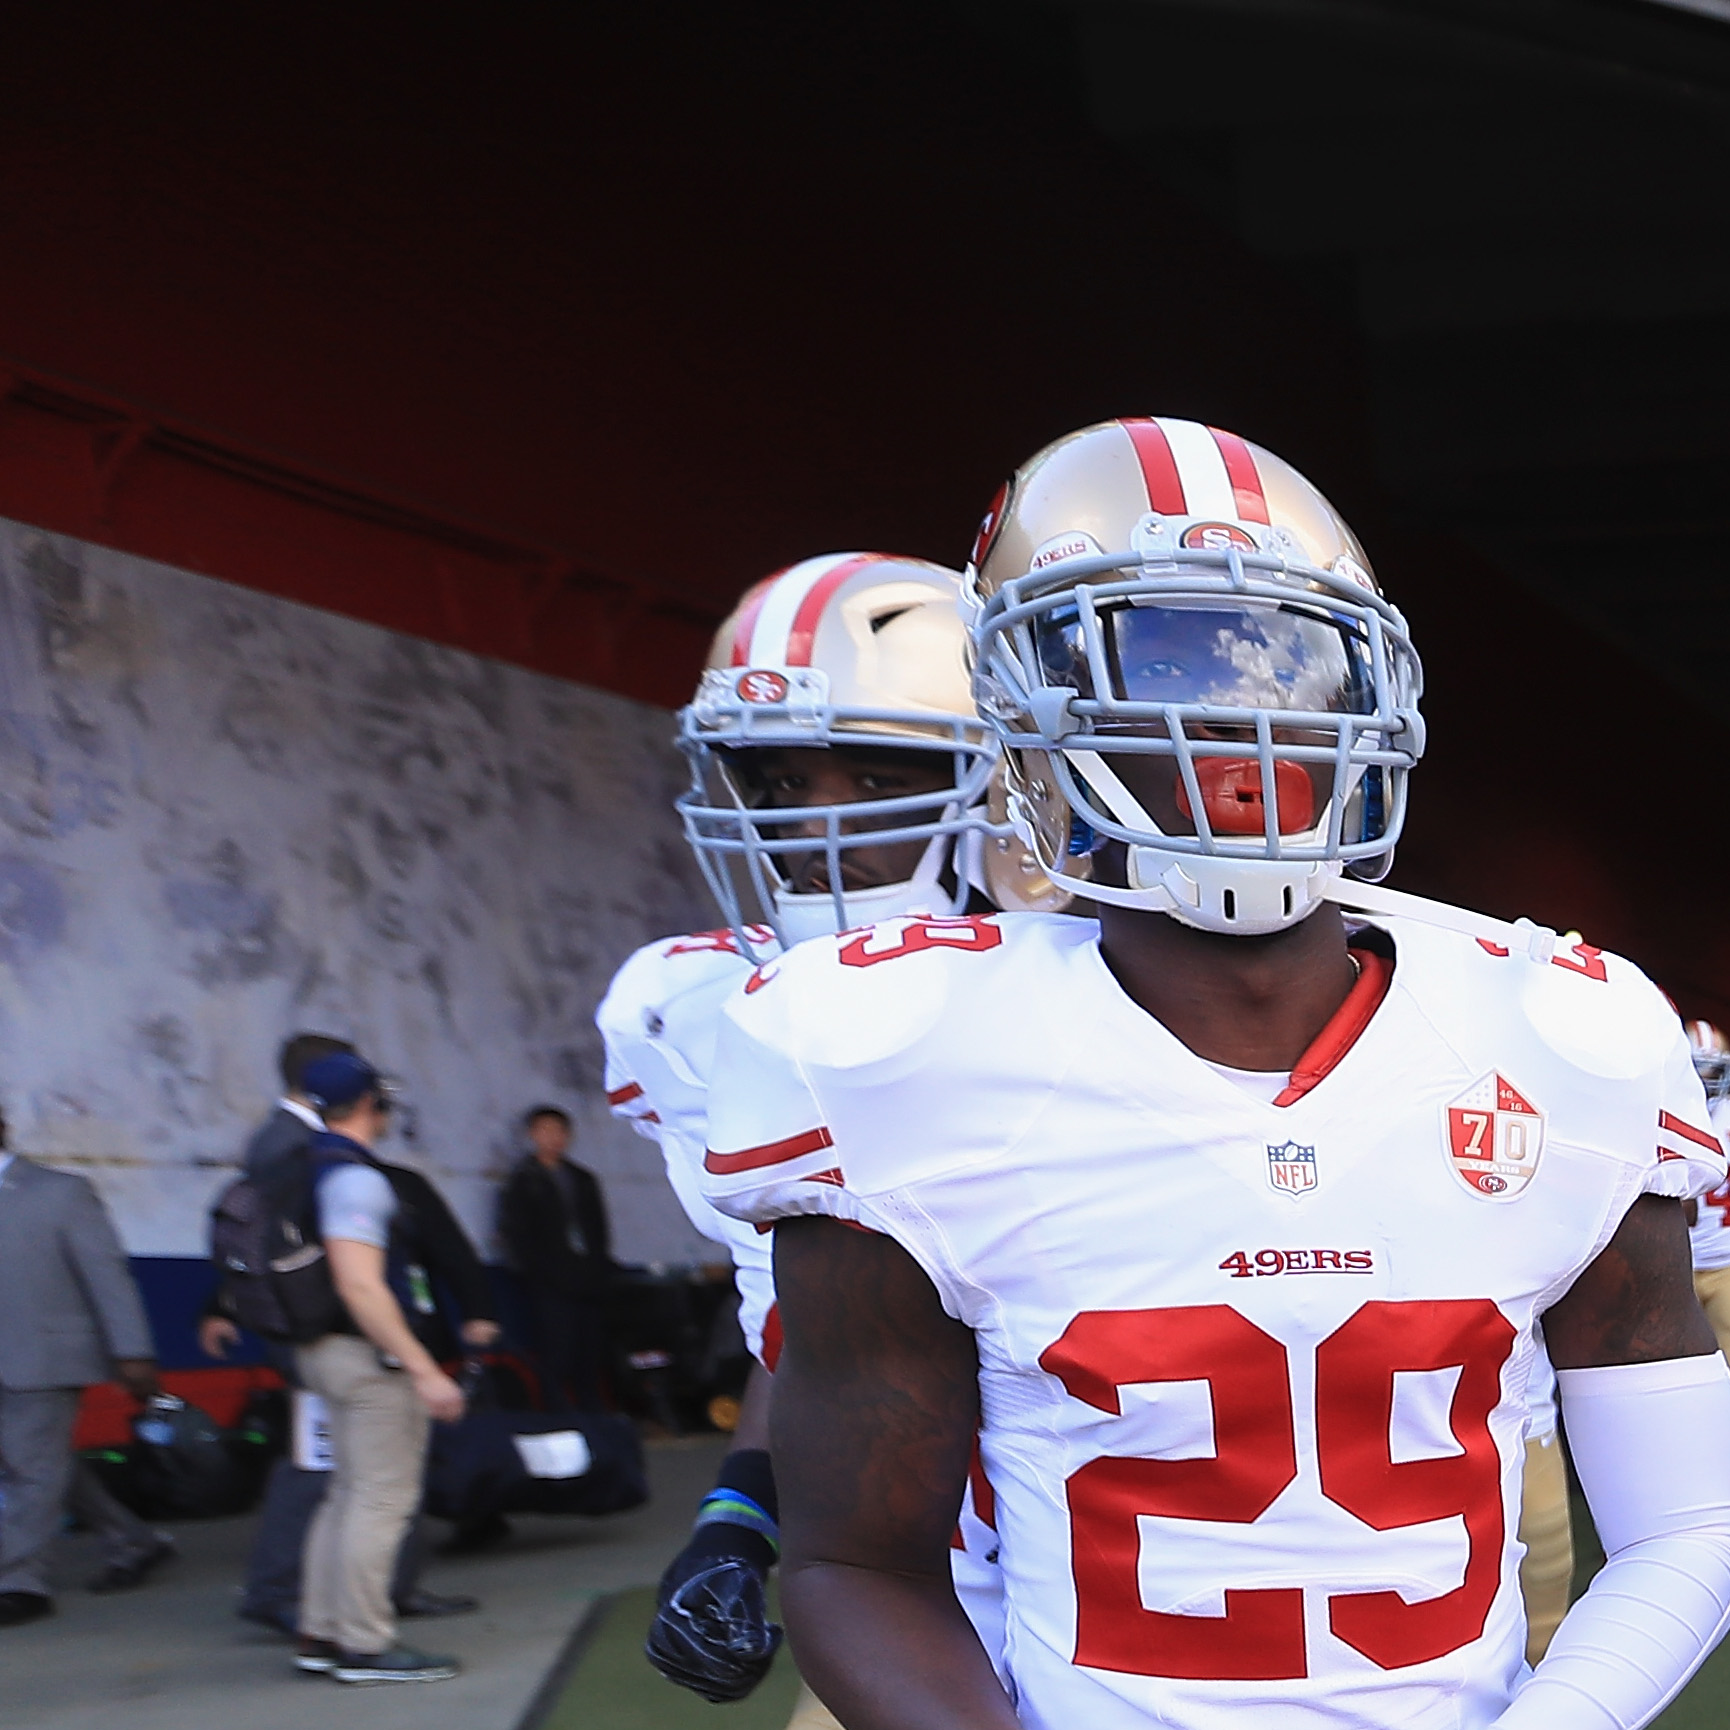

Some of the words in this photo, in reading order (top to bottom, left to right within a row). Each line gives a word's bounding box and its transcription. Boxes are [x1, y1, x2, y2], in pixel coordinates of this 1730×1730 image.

[1462, 1112, 1526, 1161] 70
[1274, 1164, 1314, 1189] NFL
[1218, 1249, 1374, 1278] 49ERS
[1039, 1298, 1518, 1680] 29
